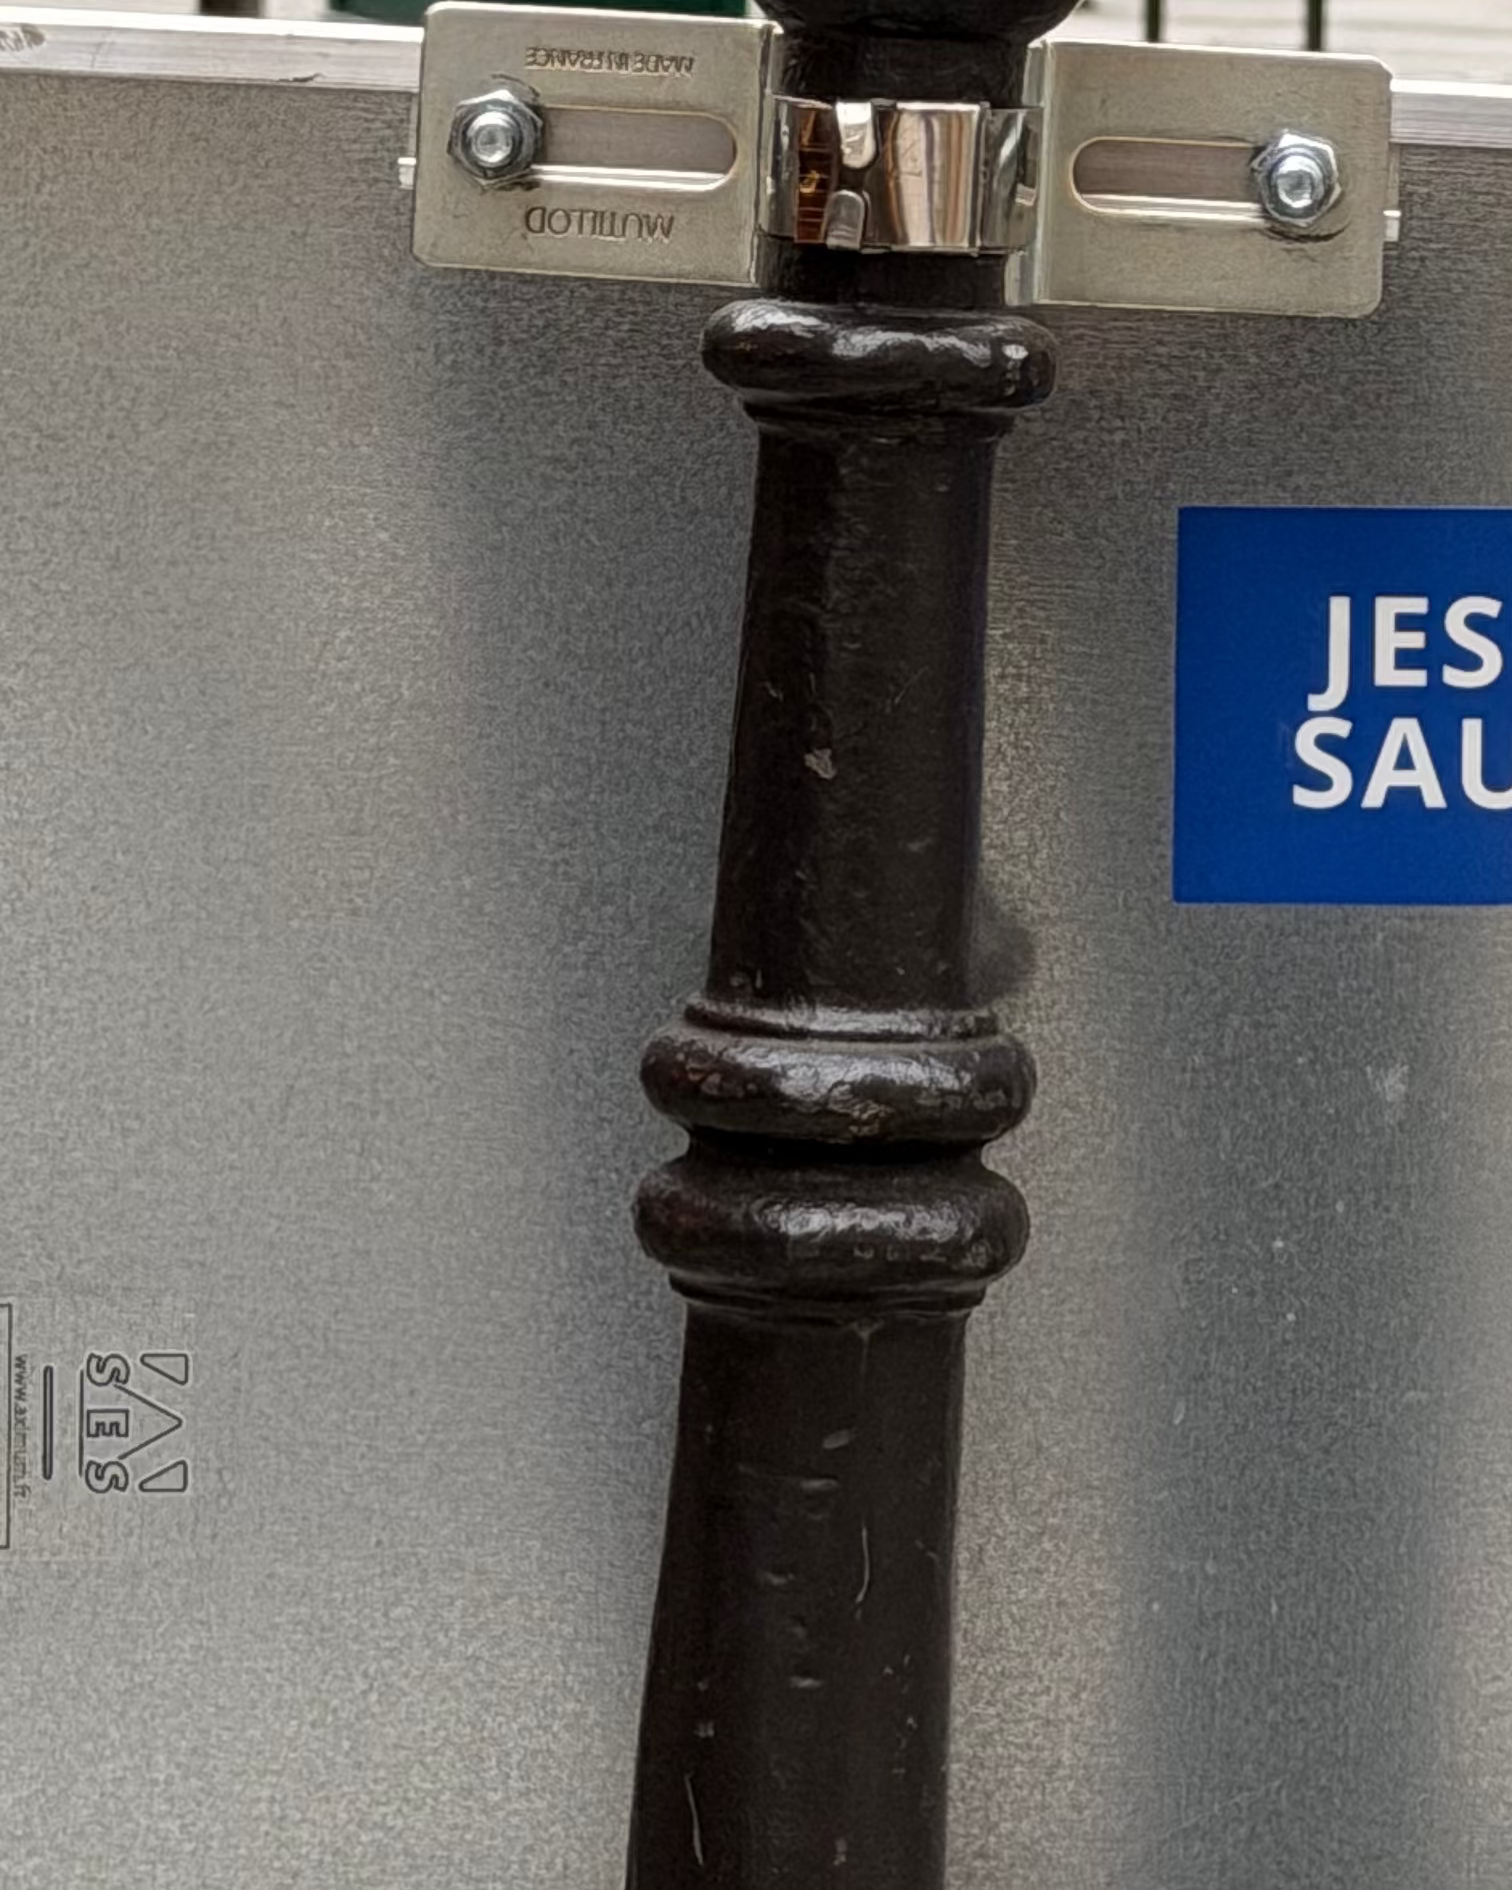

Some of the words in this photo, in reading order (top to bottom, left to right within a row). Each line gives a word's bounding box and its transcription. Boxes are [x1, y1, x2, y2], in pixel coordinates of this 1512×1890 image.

[525, 46, 604, 72] FRANCE
[606, 50, 630, 73] IN
[631, 50, 695, 77] MADE
[524, 206, 676, 244] MUTILLOD
[85, 1352, 130, 1494] SES
